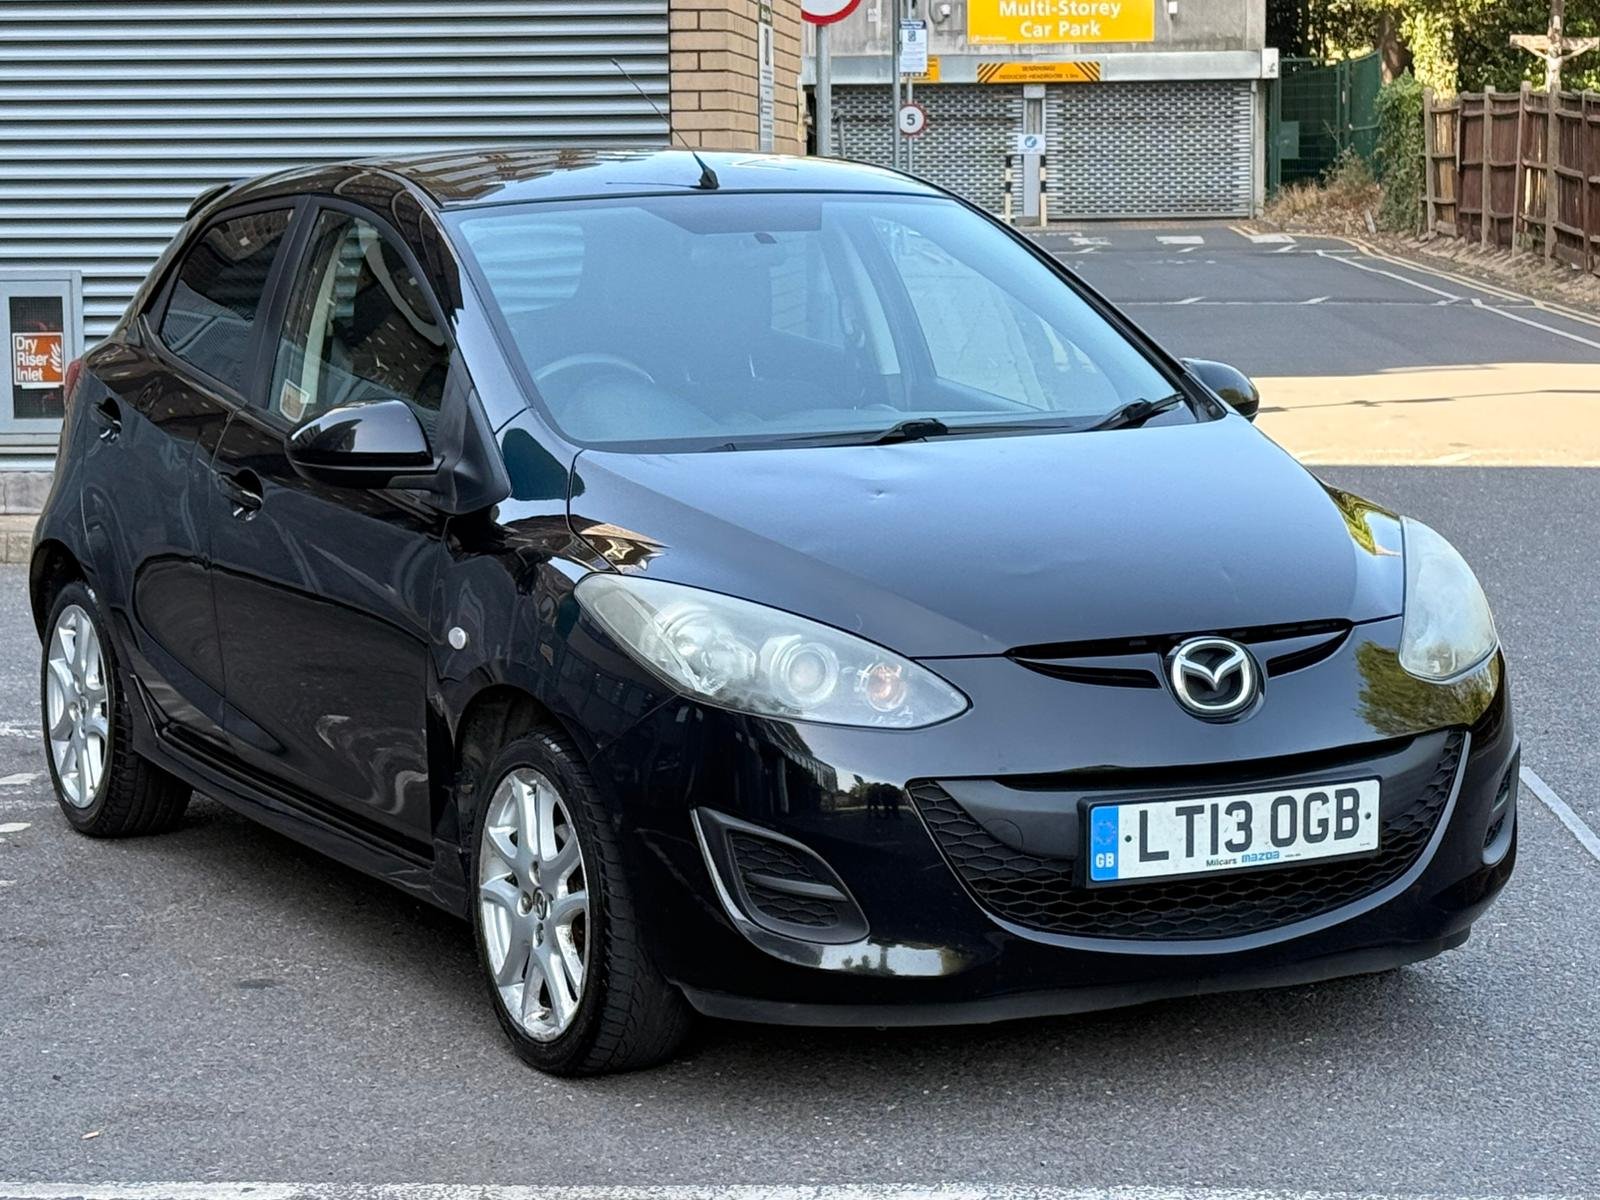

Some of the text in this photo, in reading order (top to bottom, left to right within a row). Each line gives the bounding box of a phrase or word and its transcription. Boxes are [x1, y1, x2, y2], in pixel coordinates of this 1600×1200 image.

[999, 0, 1121, 19] Multi-Storey
[1020, 21, 1051, 38] Car
[1058, 21, 1101, 37] Park
[906, 113, 916, 126] 5
[16, 336, 38, 353] Dry
[17, 351, 49, 366] Riser
[17, 367, 43, 381] Inlet
[1138, 787, 1361, 863] LT13 OGB
[1095, 852, 1114, 868] GB
[1205, 857, 1237, 867] Milcars
[1241, 850, 1280, 863] mazda
